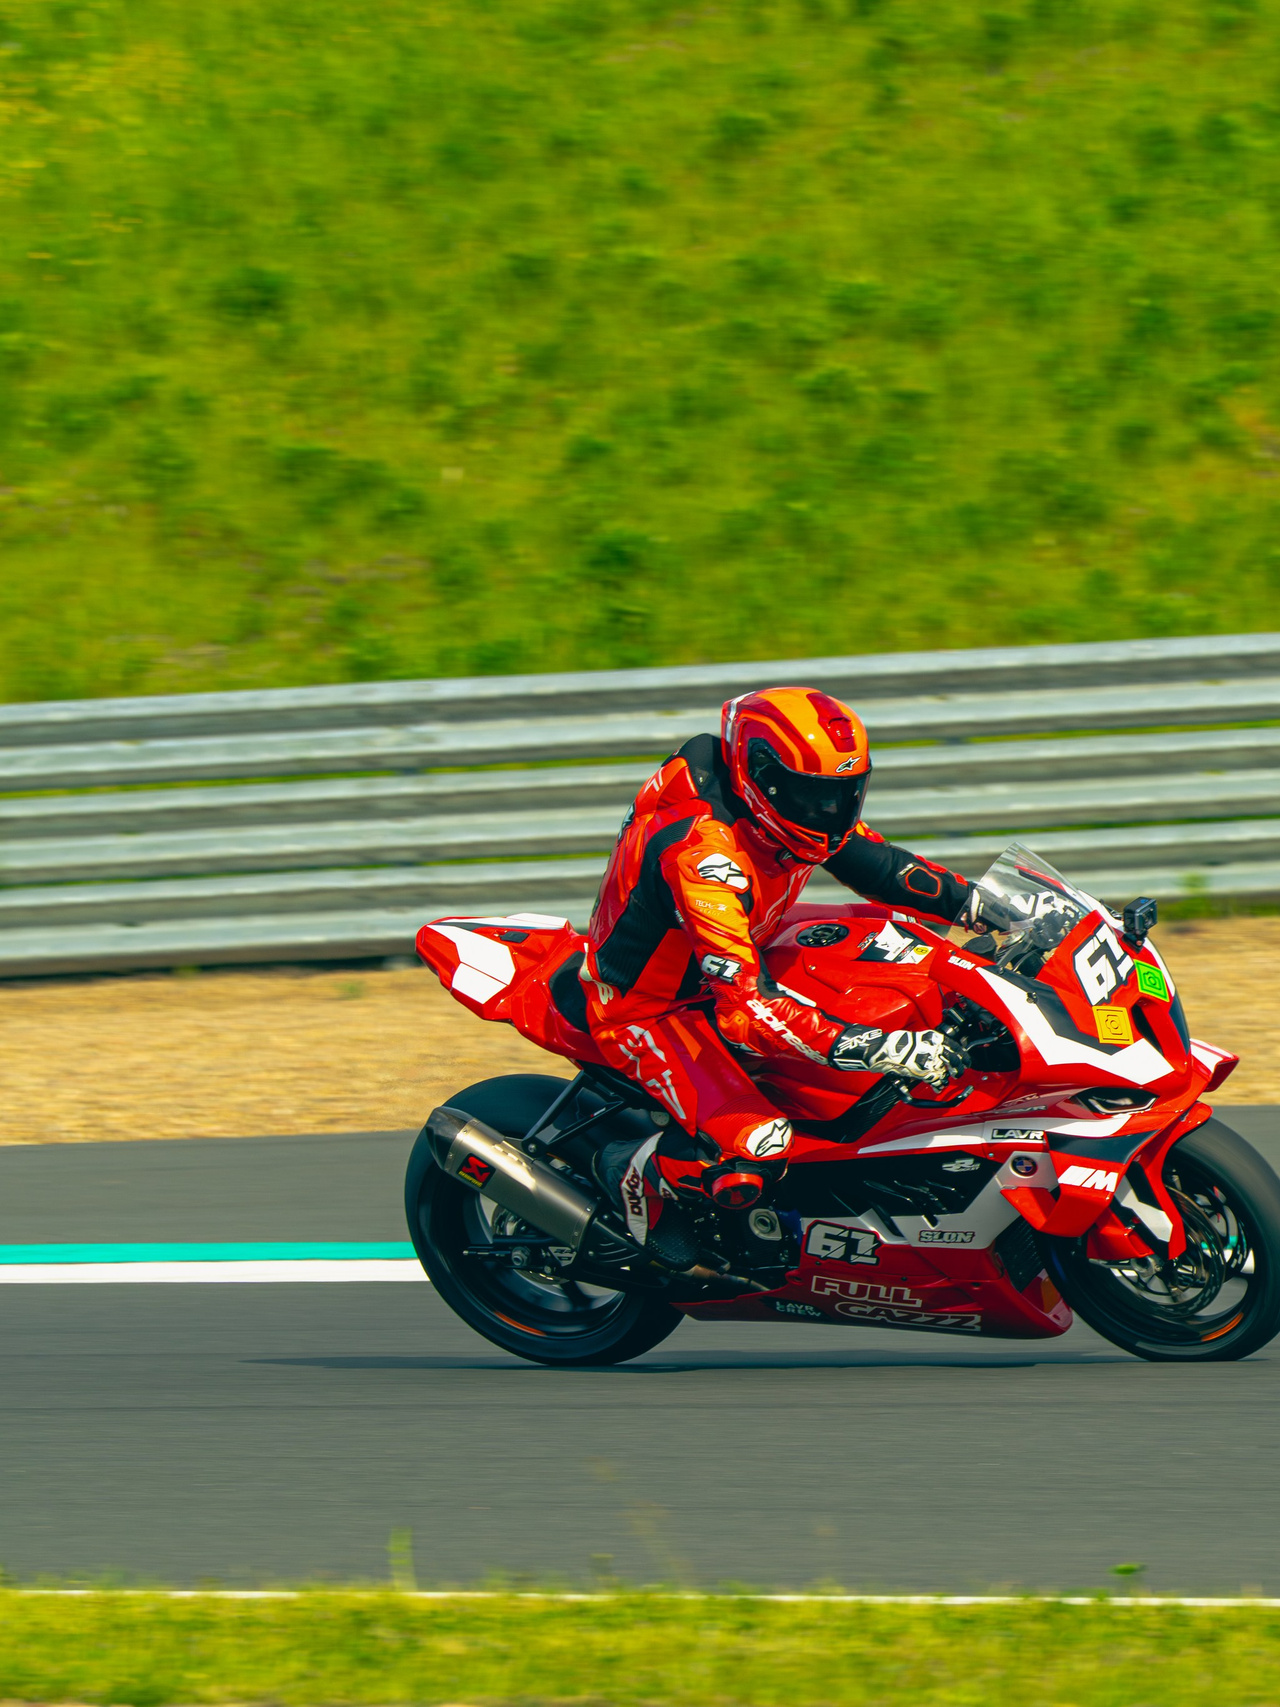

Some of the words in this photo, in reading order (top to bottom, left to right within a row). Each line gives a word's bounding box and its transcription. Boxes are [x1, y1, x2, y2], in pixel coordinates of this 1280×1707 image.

[701, 954, 741, 983] 61
[1074, 922, 1135, 1006] 61
[746, 999, 829, 1066] alpinesta
[992, 1129, 1044, 1140] LAVR
[806, 1222, 881, 1265] 61
[811, 1275, 922, 1308] FULL
[835, 1301, 981, 1332] GAZZZ
